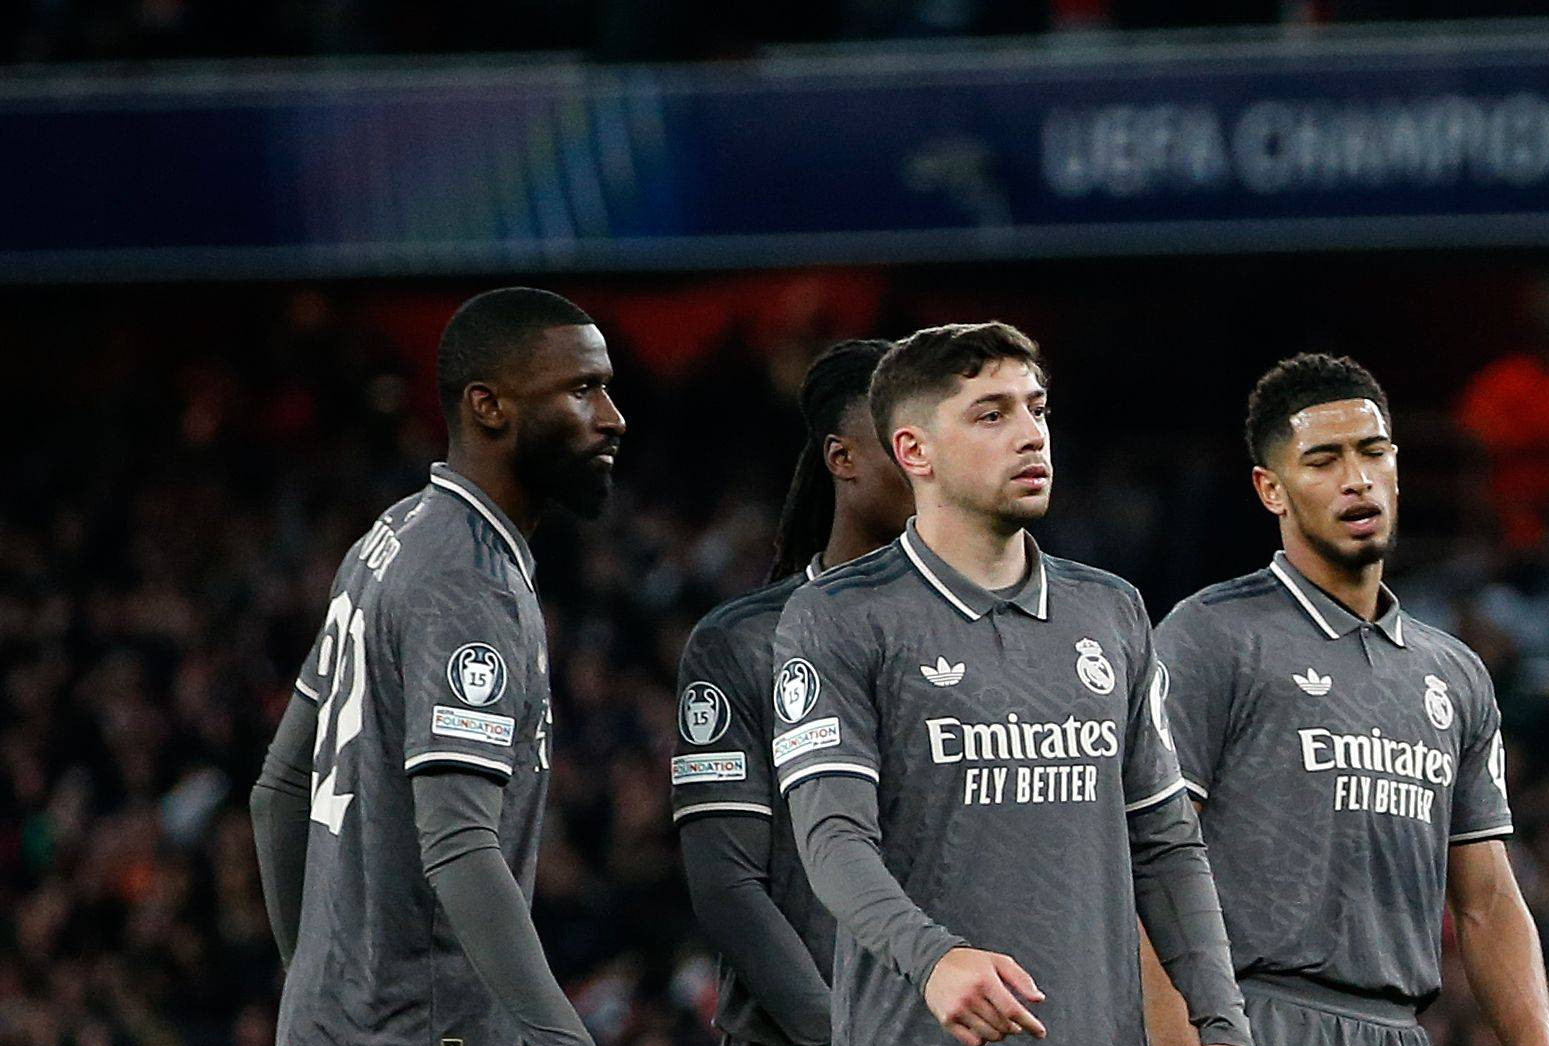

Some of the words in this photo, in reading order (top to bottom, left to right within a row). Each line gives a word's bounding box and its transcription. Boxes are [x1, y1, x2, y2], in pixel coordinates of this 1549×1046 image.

[1043, 103, 1229, 196] UEFA
[469, 671, 488, 687] 15
[789, 687, 800, 703] 15
[435, 714, 512, 737] FOUNDATION
[693, 711, 709, 726] 15
[925, 713, 1119, 764] Emirates
[1298, 727, 1452, 787] Emirates
[964, 767, 1008, 805] FLY
[1016, 765, 1097, 804] BETTER
[1334, 775, 1370, 811] FLY
[1374, 778, 1435, 824] BETTER
